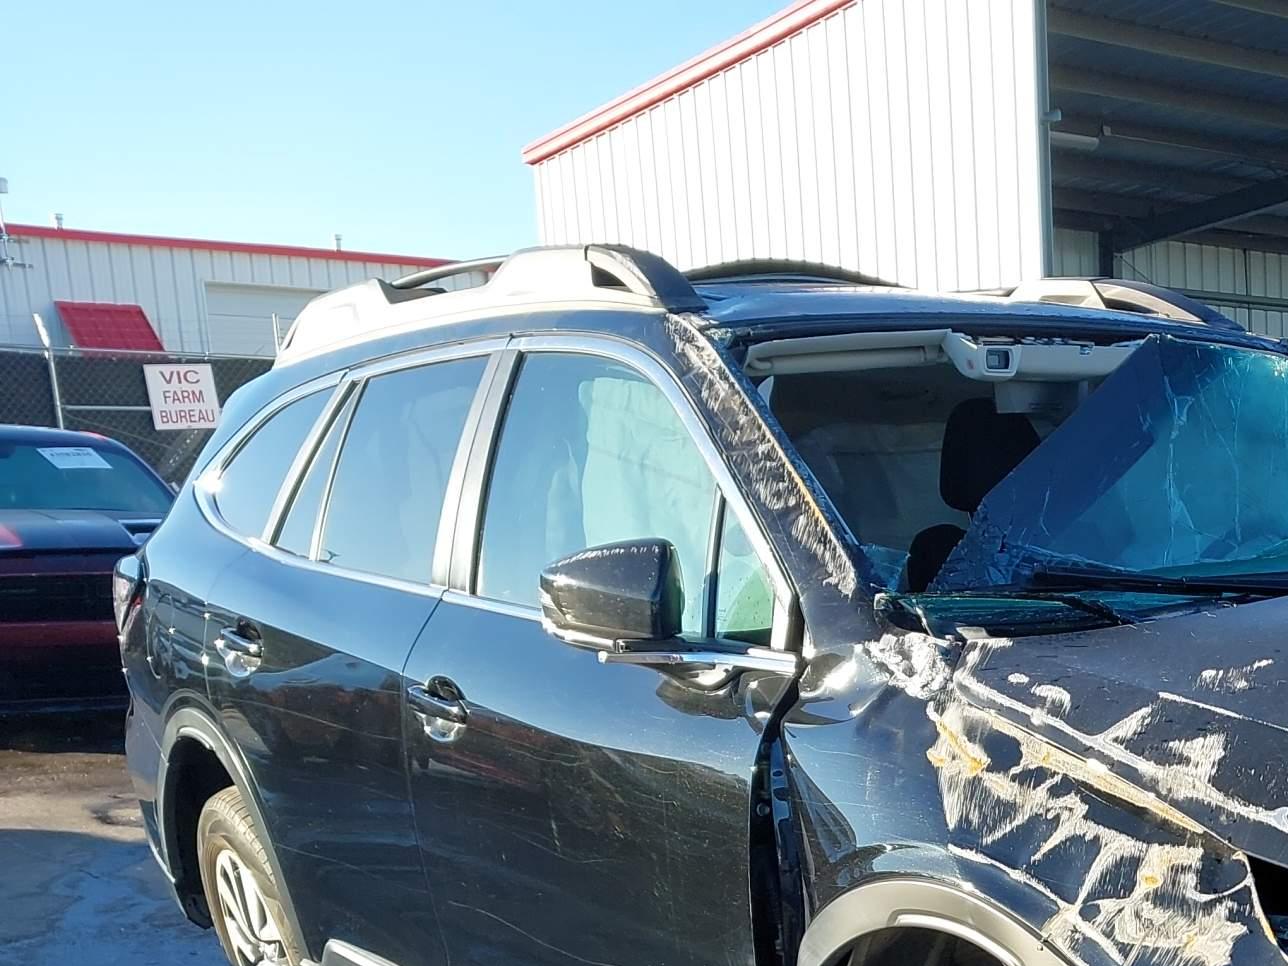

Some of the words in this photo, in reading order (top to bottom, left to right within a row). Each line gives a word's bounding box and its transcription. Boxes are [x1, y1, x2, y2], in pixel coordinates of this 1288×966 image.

[159, 369, 201, 385] VIC
[162, 389, 205, 405] FARM
[160, 408, 216, 424] BUREAU
